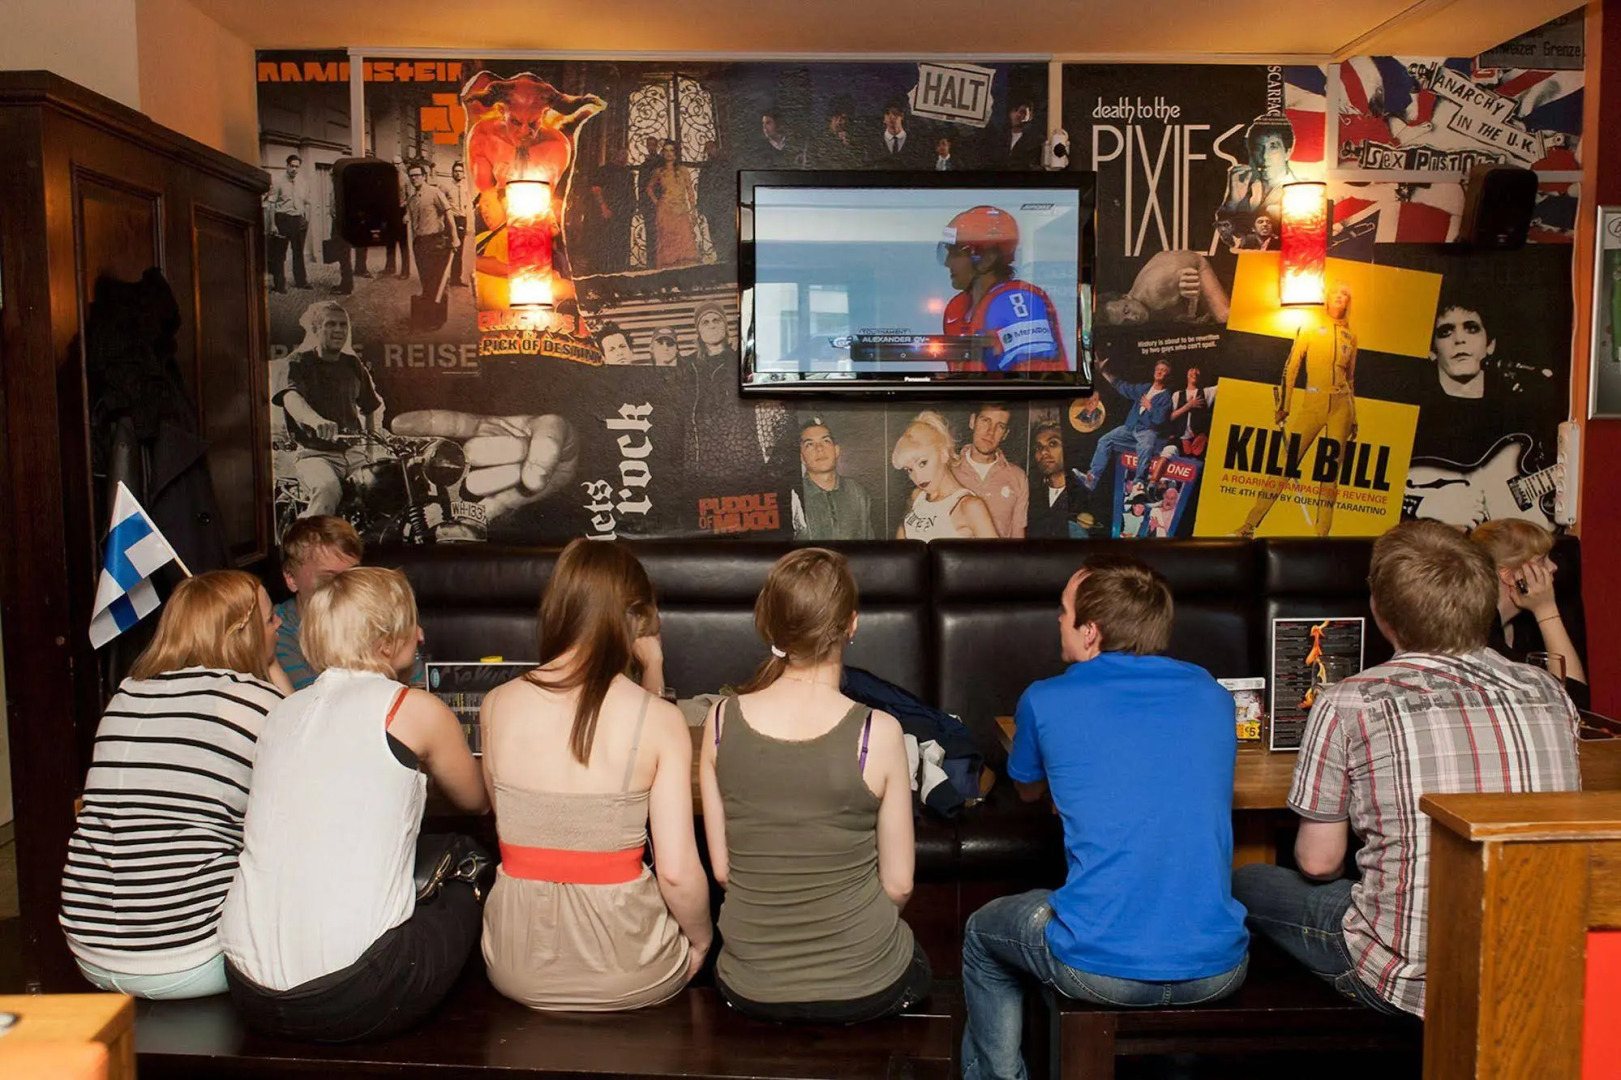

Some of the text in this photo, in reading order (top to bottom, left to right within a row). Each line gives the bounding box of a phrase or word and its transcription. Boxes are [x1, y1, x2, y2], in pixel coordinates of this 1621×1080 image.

[1543, 41, 1581, 57] Grenze
[922, 72, 985, 112] HALT
[1437, 74, 1505, 116] ANARCHY
[1092, 96, 1181, 124] death to the
[1456, 114, 1536, 155] IN THE U.K.
[1009, 293, 1029, 318] 8
[383, 344, 478, 368] REISE
[482, 339, 602, 363] PICK OF DESTIN
[1137, 340, 1157, 348] History
[605, 402, 654, 515] rock
[1223, 424, 1391, 491] KILL BILL
[1220, 485, 1387, 515] THE 4TH FILM BY QUENTIN TARANTINO
[1221, 474, 1388, 504] A ROARING RAMPAGE OF REVENGE
[699, 493, 778, 515] PUDDLE
[699, 516, 713, 529] OF
